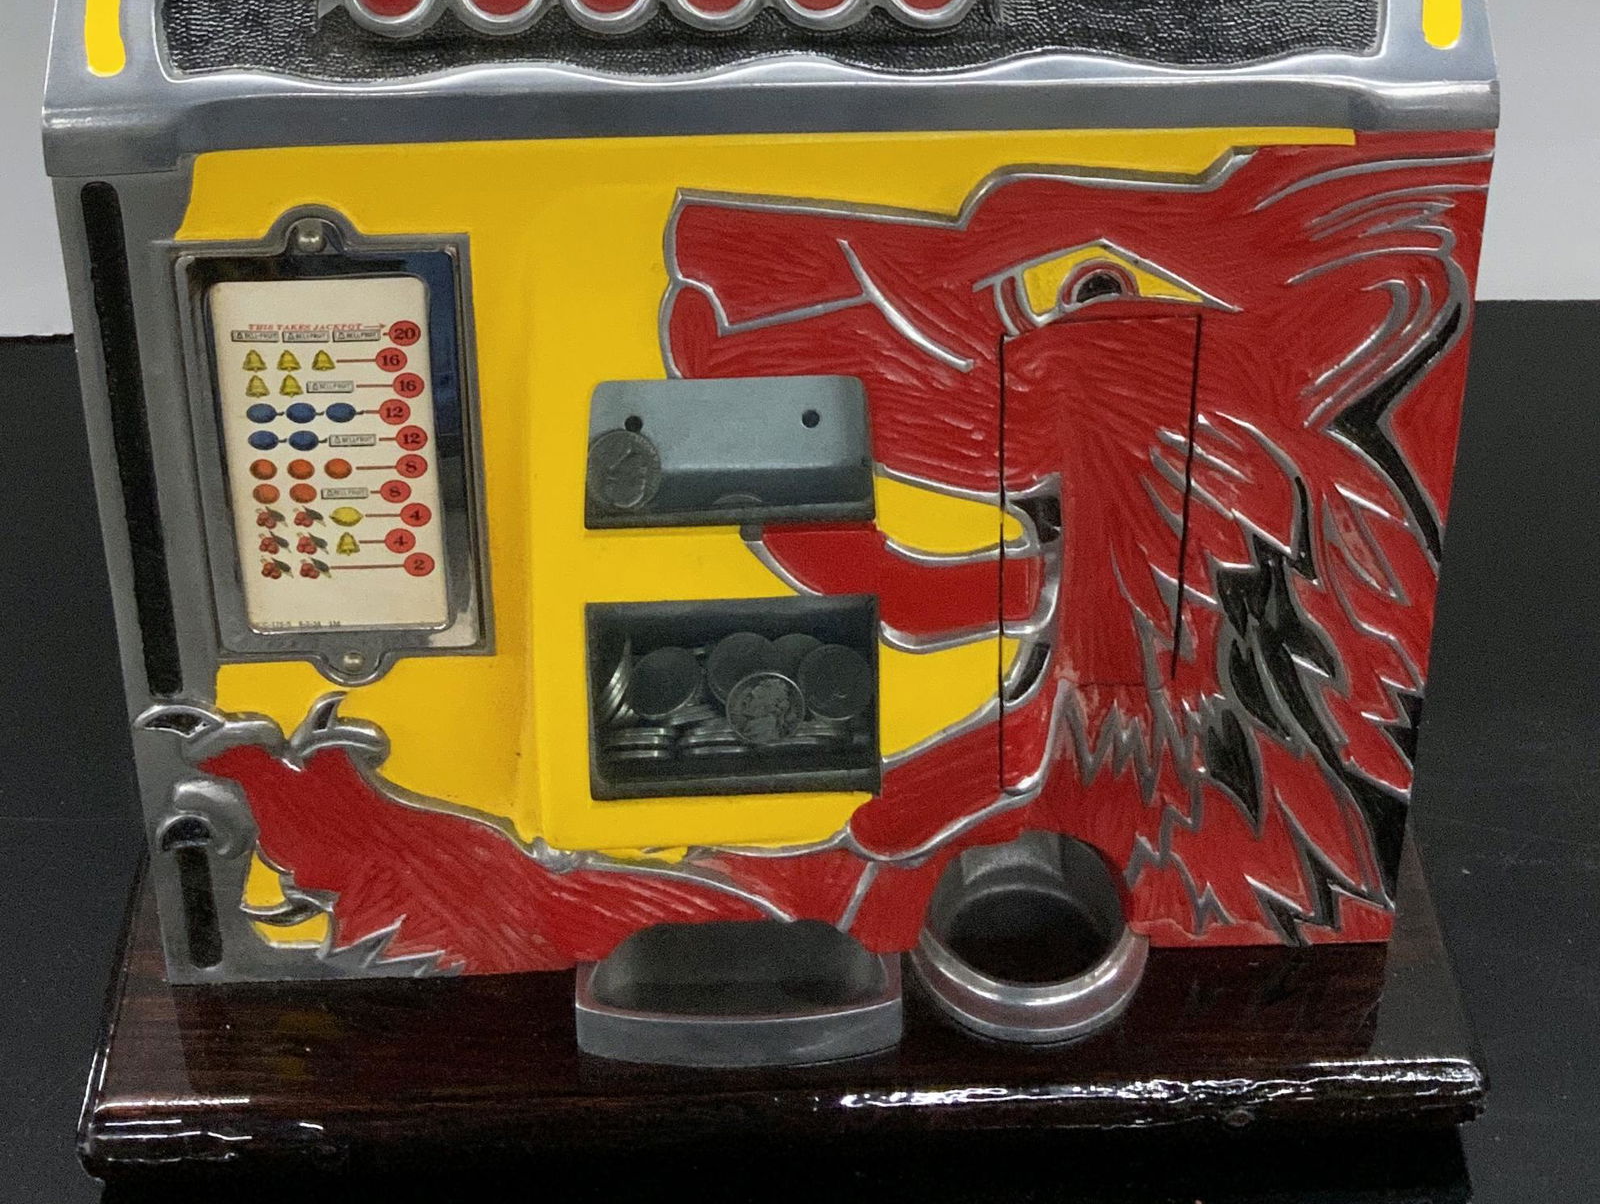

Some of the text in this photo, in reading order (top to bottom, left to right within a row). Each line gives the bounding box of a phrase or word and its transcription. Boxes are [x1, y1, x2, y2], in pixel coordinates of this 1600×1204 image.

[277, 323, 310, 331] TAKES
[312, 323, 364, 331] JACKPOT
[394, 327, 416, 340] 20
[381, 354, 401, 366] 16
[399, 379, 417, 392] 16
[385, 406, 404, 418] 12
[403, 432, 421, 444] 12
[405, 460, 418, 473] 8
[388, 486, 402, 497] 8
[409, 509, 422, 521] 4
[393, 535, 408, 547] 4
[413, 559, 425, 571] 2
